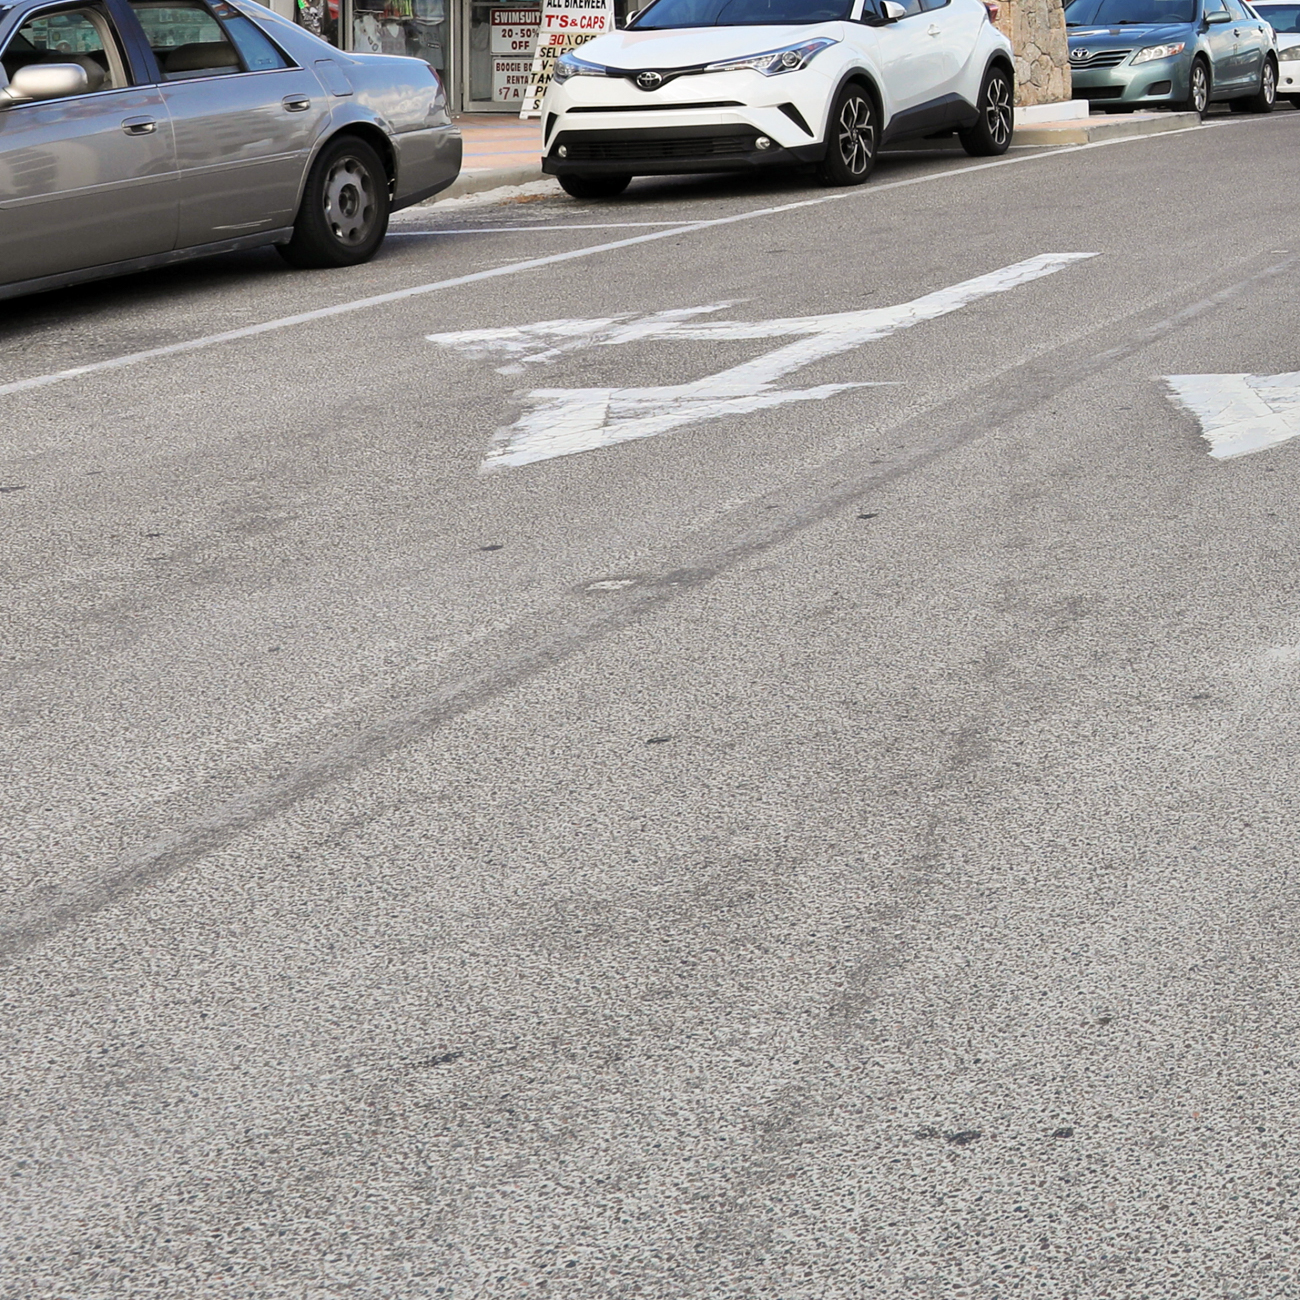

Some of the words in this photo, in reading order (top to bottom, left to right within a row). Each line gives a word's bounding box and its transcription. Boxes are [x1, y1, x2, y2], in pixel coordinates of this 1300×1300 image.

[545, 15, 569, 28] T'S
[580, 16, 605, 30] CAPS
[511, 41, 530, 50] OFF
[496, 63, 521, 72] BOOGIE
